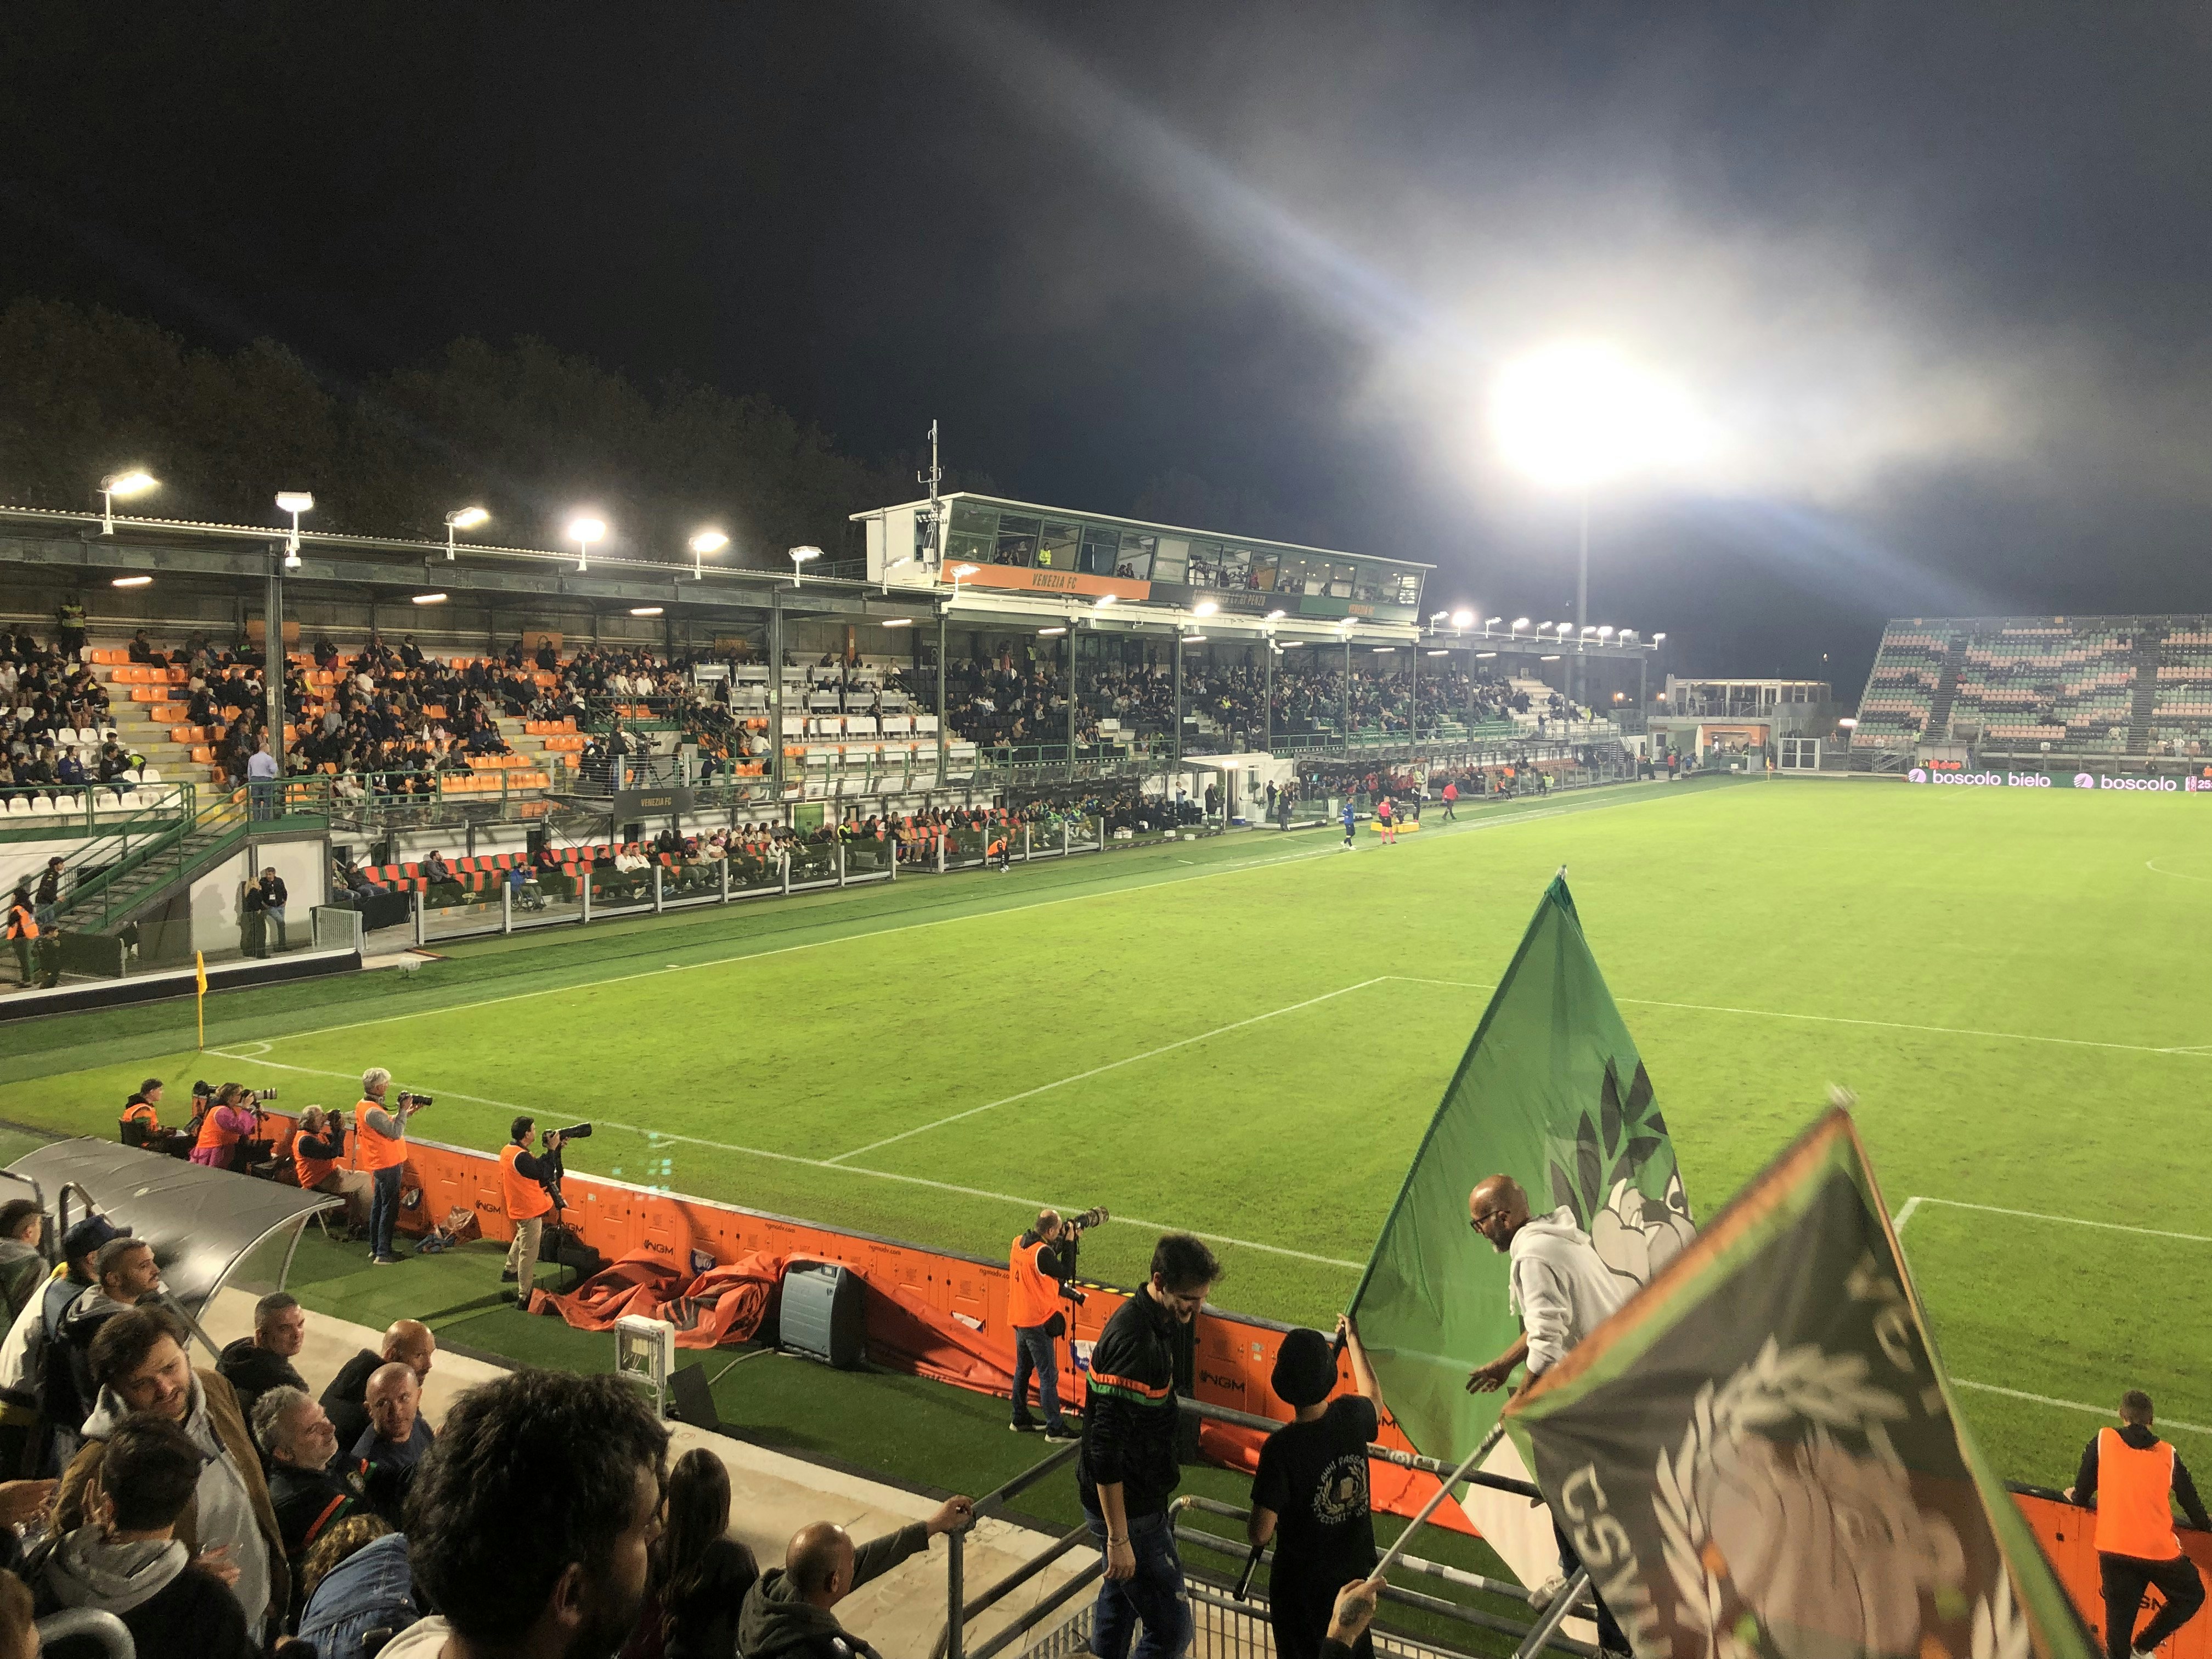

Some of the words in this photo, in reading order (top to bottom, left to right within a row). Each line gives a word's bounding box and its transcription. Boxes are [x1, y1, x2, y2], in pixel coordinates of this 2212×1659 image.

[1032, 573, 1065, 588] VENEZIA
[1067, 577, 1077, 589] FC
[1933, 769, 2001, 786] boscolo
[2008, 771, 2051, 787] bielo
[2101, 774, 2177, 791] boscolo
[2198, 780, 2212, 789] 25
[641, 798, 664, 807] VENEZIA
[664, 797, 672, 806] FC
[644, 1239, 674, 1256] NGM
[979, 1268, 1009, 1280] ngmadv.co
[1199, 1370, 1245, 1394] NGM
